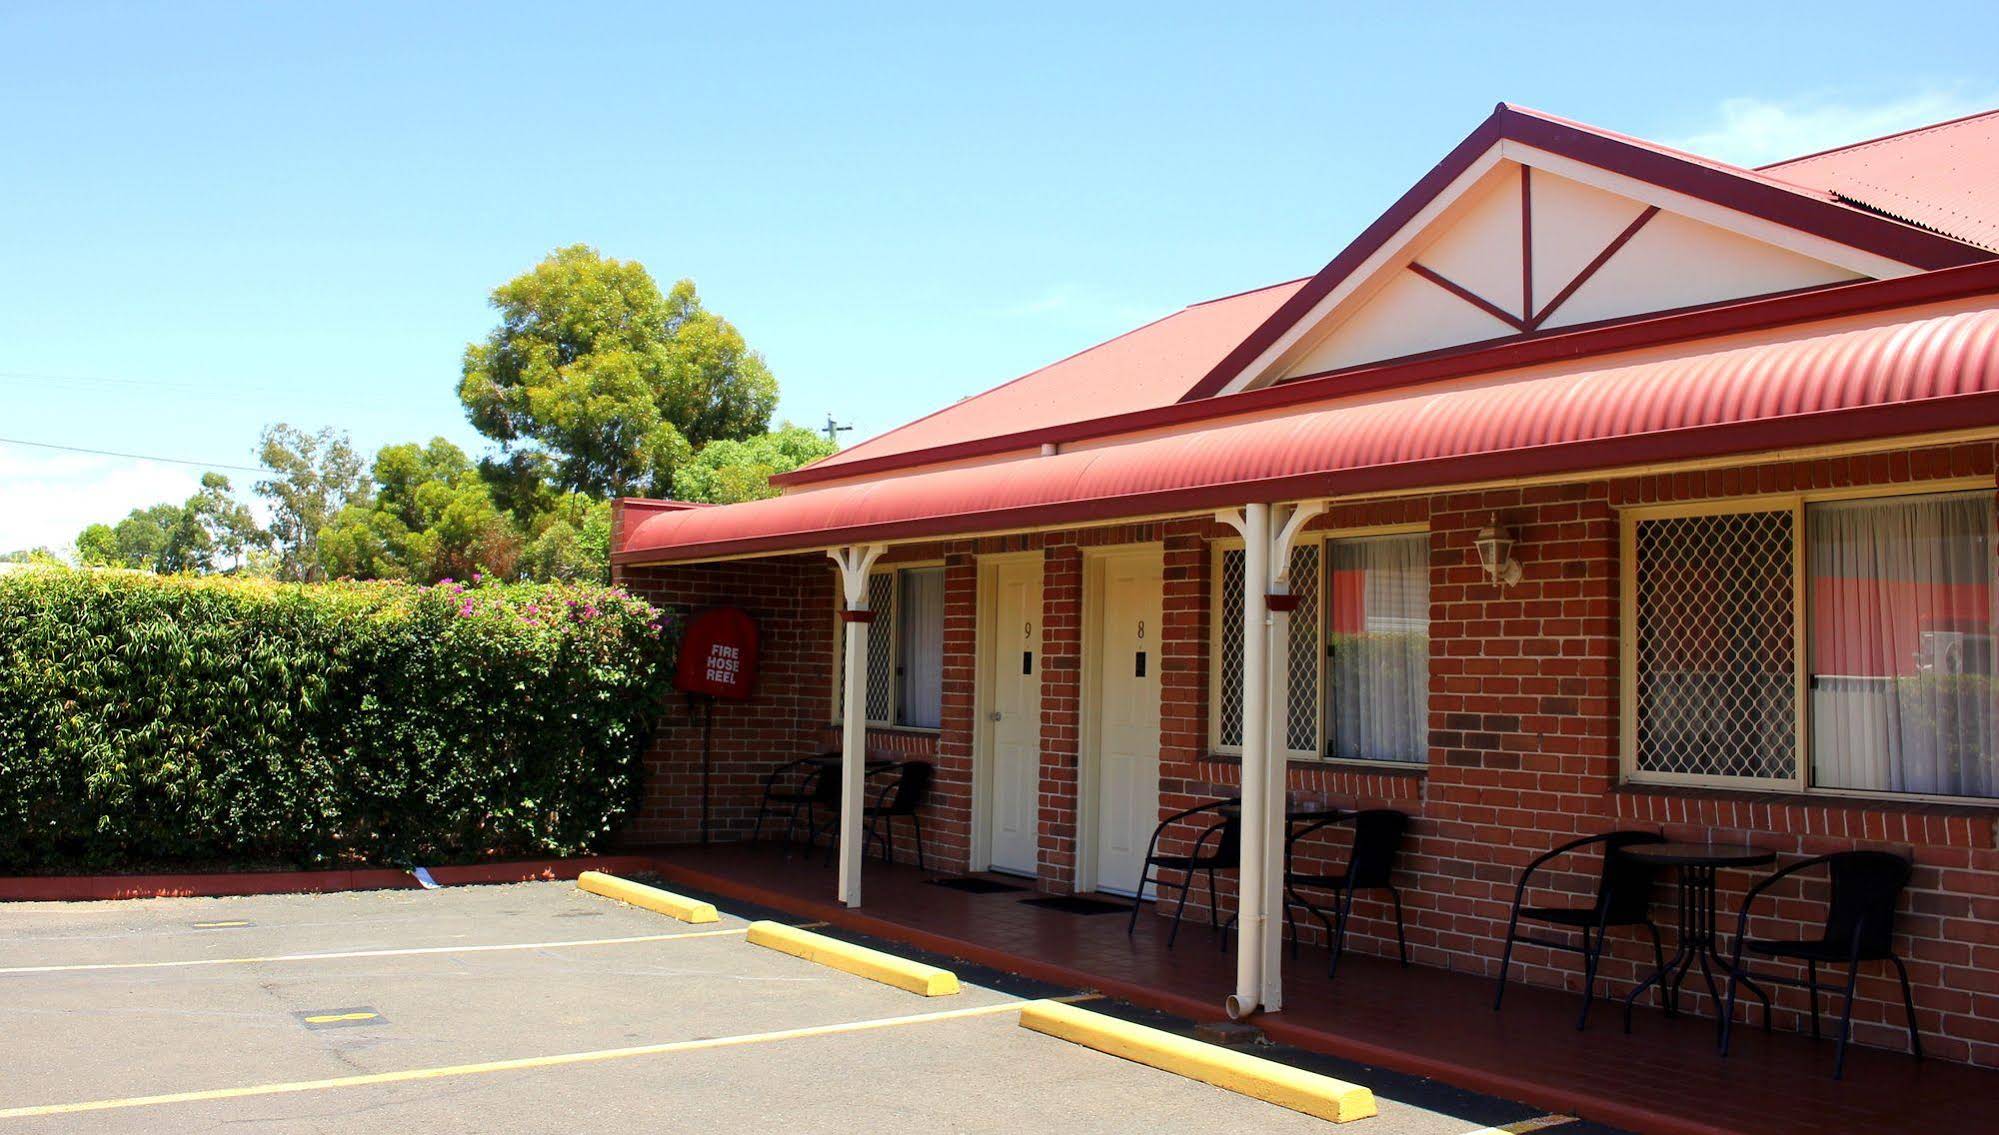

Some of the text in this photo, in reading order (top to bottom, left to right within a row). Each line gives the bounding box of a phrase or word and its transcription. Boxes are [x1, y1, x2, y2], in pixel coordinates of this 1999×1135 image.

[1024, 621, 1032, 639] 9
[1137, 620, 1145, 639] 8
[711, 643, 740, 660] FIRE
[706, 655, 740, 673] HOSE
[706, 668, 736, 685] REEL
